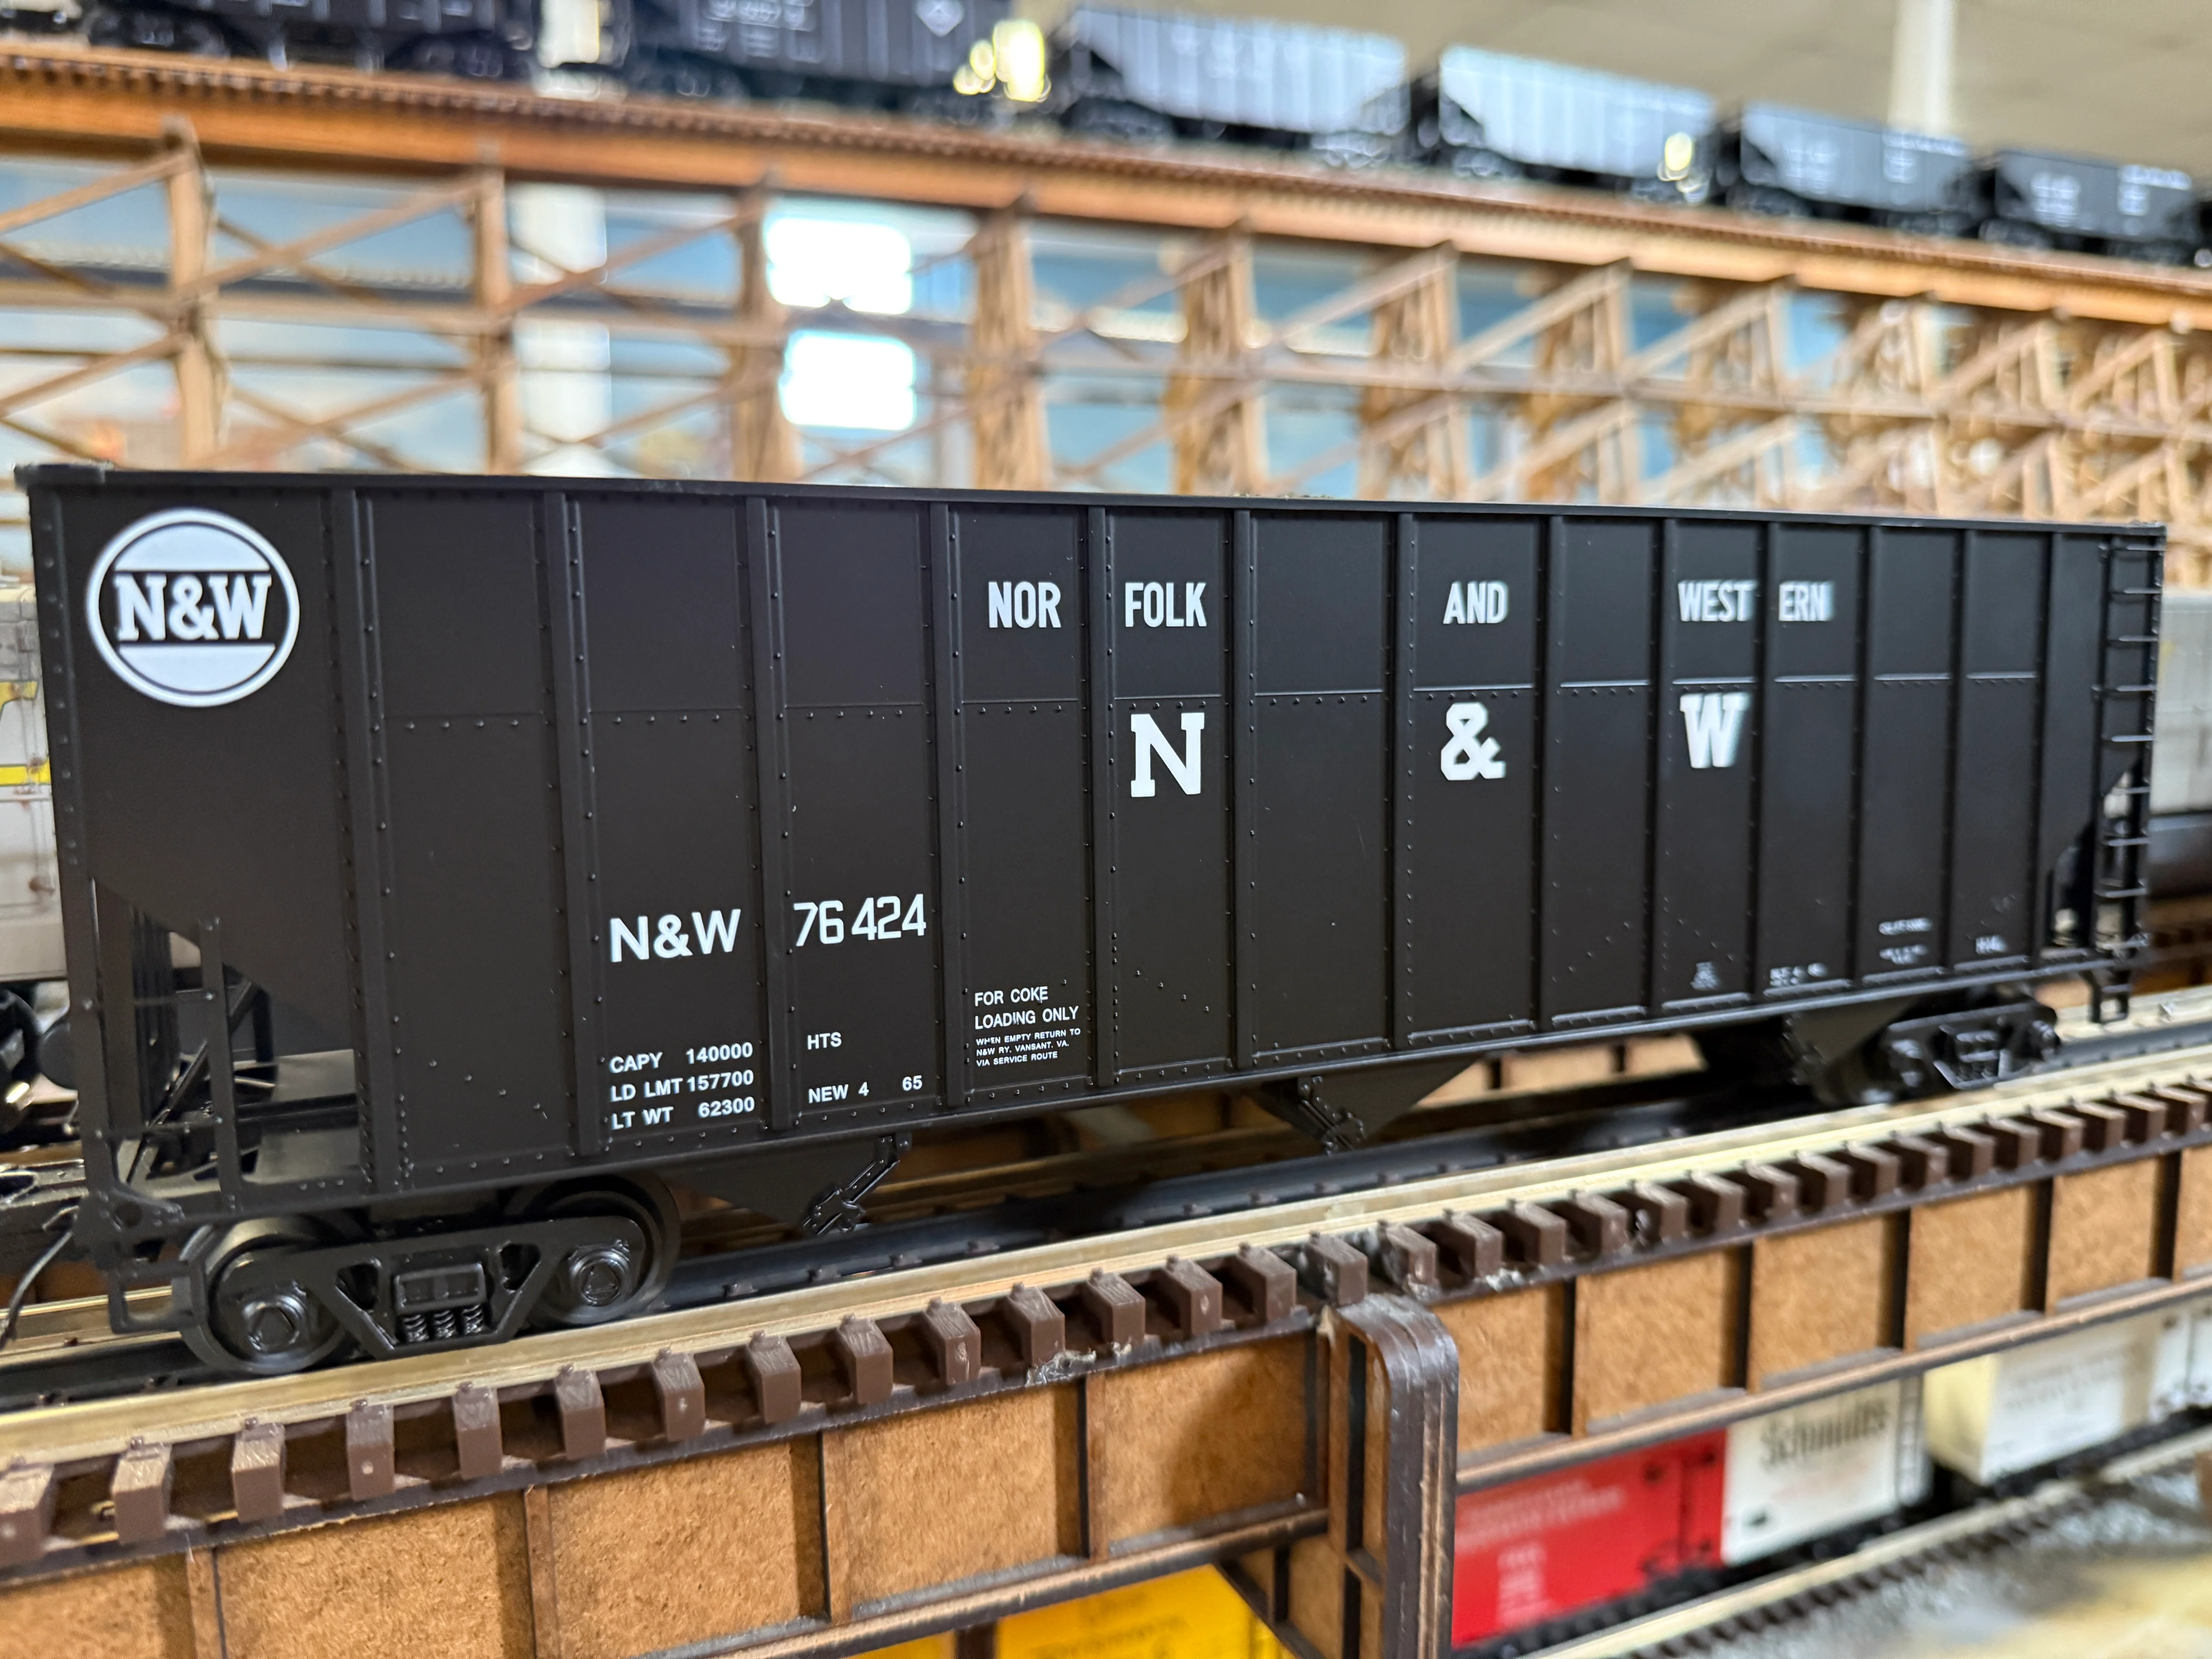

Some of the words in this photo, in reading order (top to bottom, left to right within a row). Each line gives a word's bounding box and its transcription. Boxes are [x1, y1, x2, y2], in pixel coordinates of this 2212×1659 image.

[114, 574, 272, 641] N&W
[988, 581, 1061, 629] NOR
[1125, 581, 1207, 627] FOLK
[1443, 581, 1509, 624] AND
[1678, 580, 1757, 622] WEST
[1778, 581, 1834, 622] ERN
[1131, 712, 1205, 797] N
[1441, 702, 1506, 781] &
[1680, 692, 1750, 769] W
[610, 908, 741, 963] N&W
[975, 990, 1004, 1006] FOR
[1010, 986, 1048, 1003] COKE
[975, 1010, 1036, 1030] LOADING
[1042, 1005, 1079, 1022] ONLY
[807, 1032, 842, 1050] HTS
[976, 1036, 1001, 1046] WHEN
[1004, 1033, 1031, 1042] EMPTY
[1034, 1029, 1066, 1039] RETURN
[1069, 1028, 1081, 1036] TO
[976, 1048, 995, 1056] N&W
[610, 1052, 663, 1073] CAPY
[686, 1042, 753, 1064] 140000
[993, 1054, 1027, 1065] SERVICE
[1031, 1051, 1058, 1061] ROUTE
[611, 1084, 636, 1102] LD
[644, 1077, 683, 1098] LMT
[687, 1069, 754, 1092] 157700
[808, 1084, 849, 1104] NEW
[858, 1082, 869, 1096] 4
[902, 1075, 922, 1091] 65
[612, 1111, 635, 1130] LT
[642, 1106, 674, 1125] WT
[698, 1096, 755, 1118] 62300
